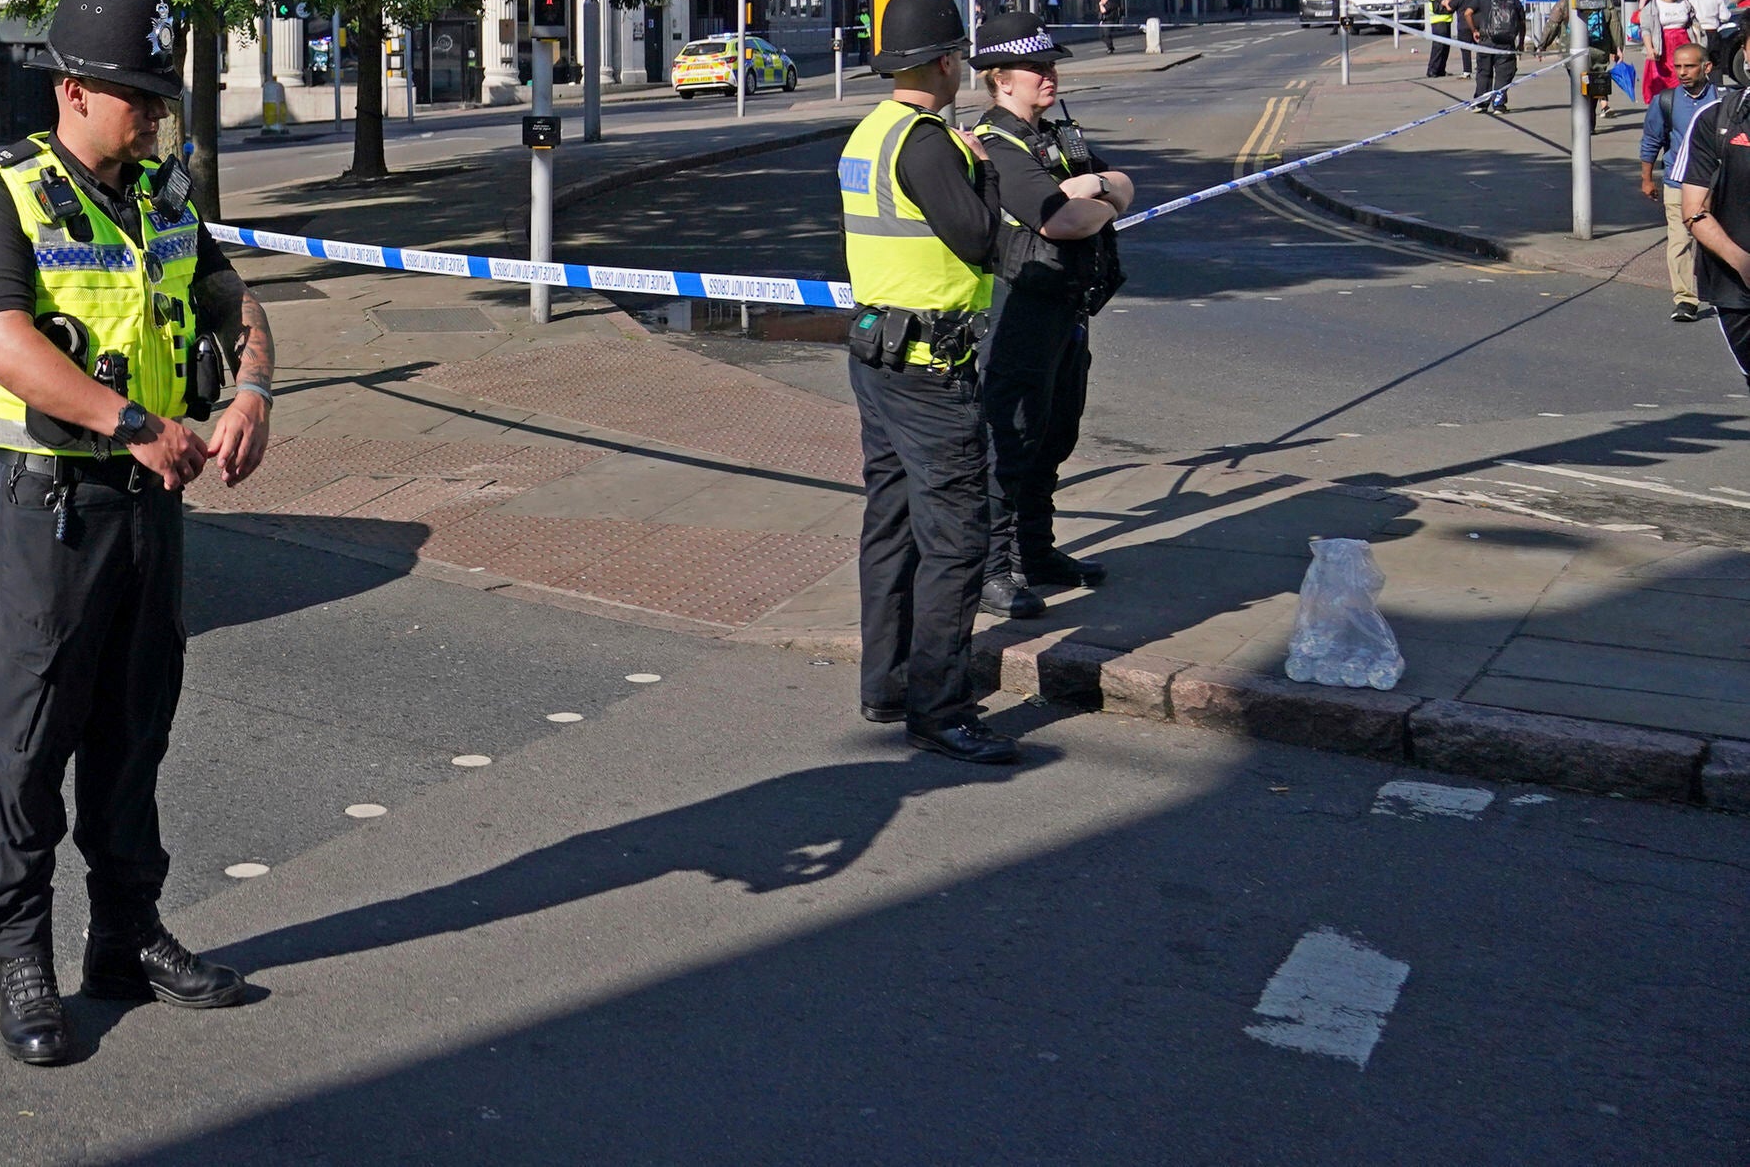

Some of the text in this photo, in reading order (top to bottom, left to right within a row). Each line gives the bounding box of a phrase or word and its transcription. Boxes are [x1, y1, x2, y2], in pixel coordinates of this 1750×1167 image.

[328, 244, 380, 263] POLICE LINE DO NOT CROSS
[405, 253, 465, 272] POLICE LINE DO NOT CROSS
[494, 261, 561, 281] POLICE LINE DO NOT CROSS
[595, 270, 671, 291] POLICE LINE DO NOT CROSS
[709, 278, 795, 300] POLICE LINE DO NOT CROSS
